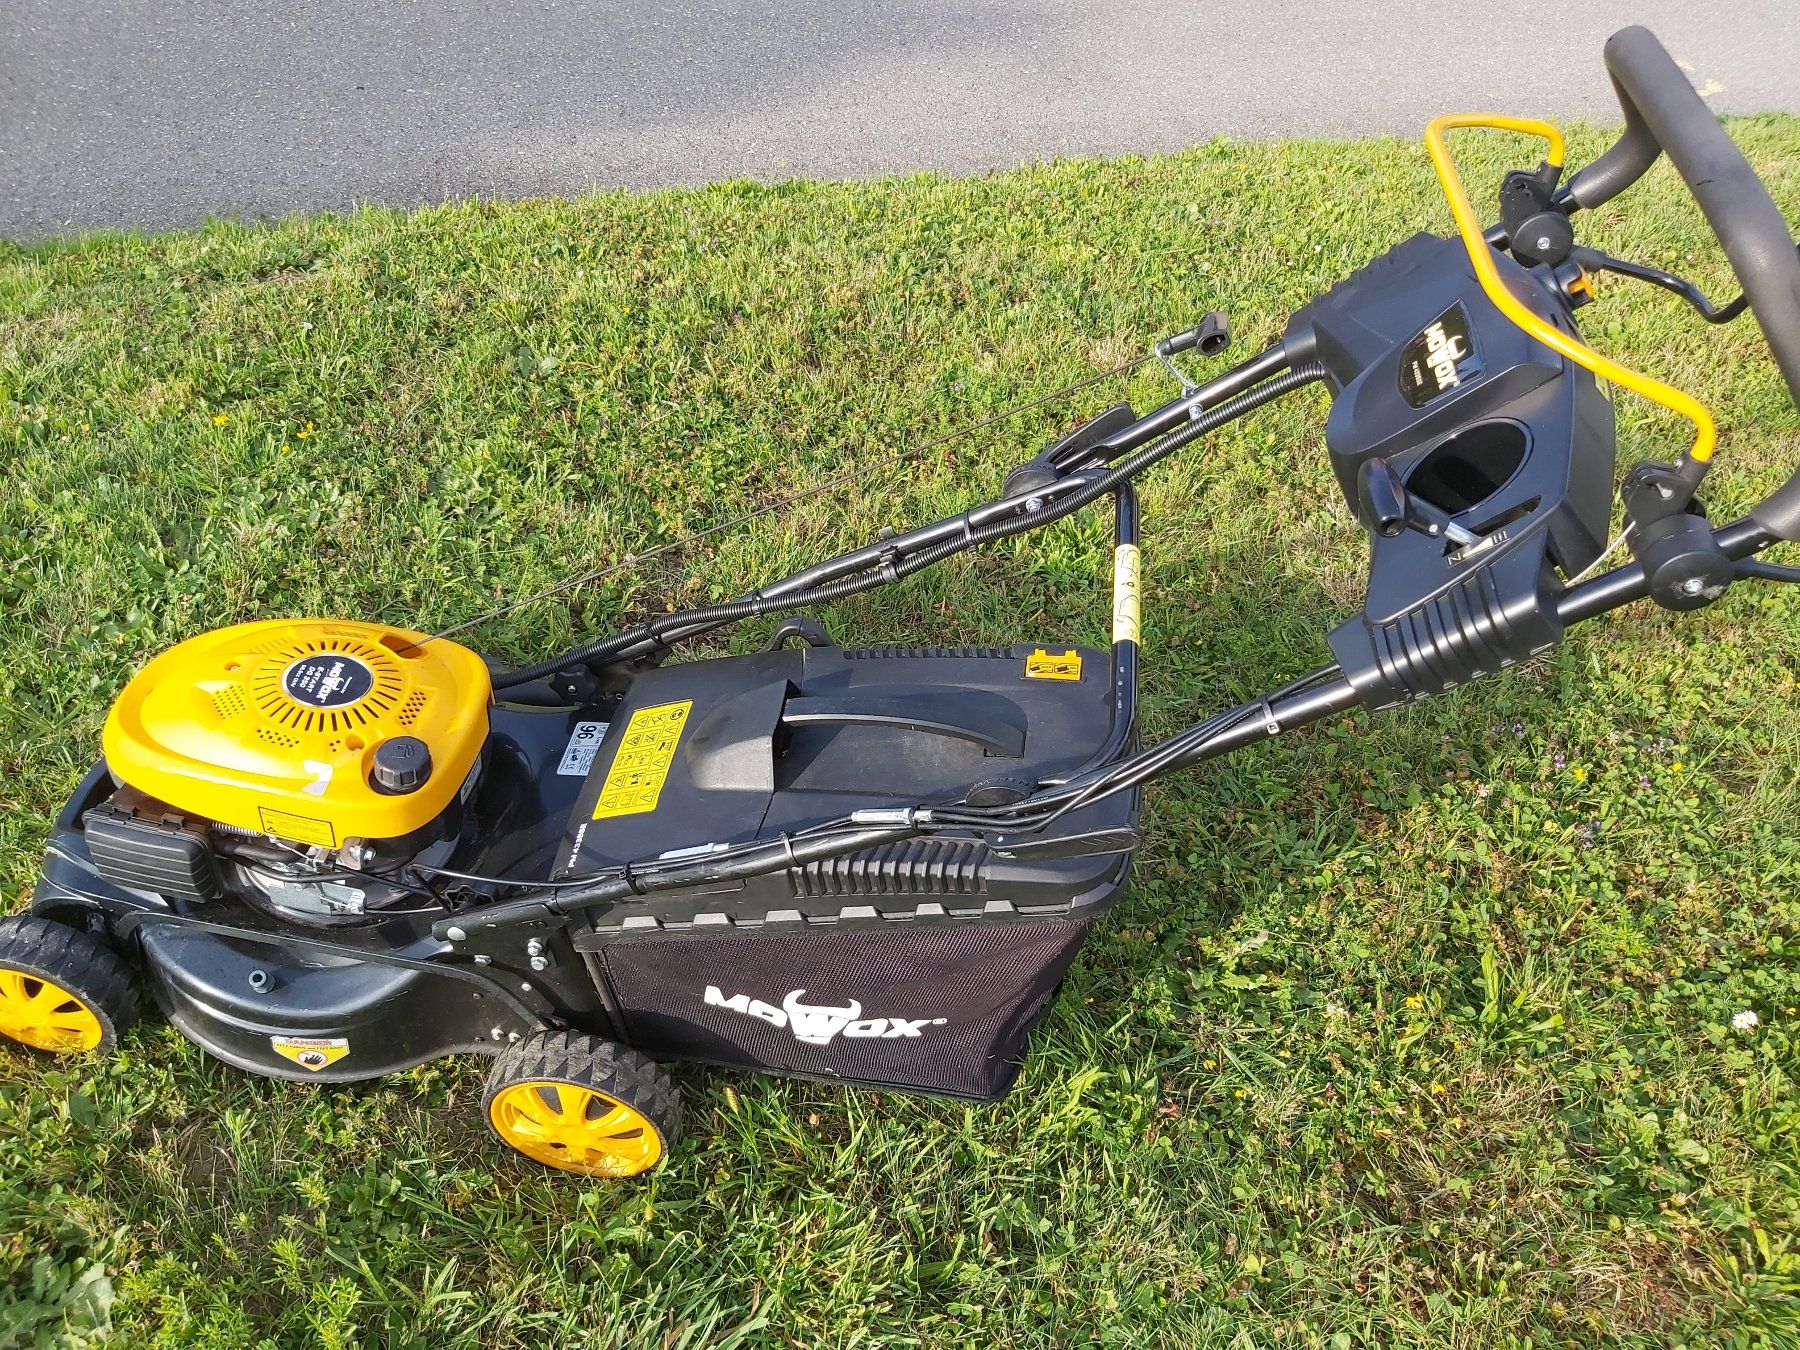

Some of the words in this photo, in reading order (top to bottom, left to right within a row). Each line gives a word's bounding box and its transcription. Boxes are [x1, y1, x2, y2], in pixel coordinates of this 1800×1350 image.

[1424, 321, 1466, 391] MOWOX
[305, 666, 325, 693] E-START
[316, 661, 346, 703] MOWOX
[577, 725, 598, 740] 96
[568, 854, 578, 868] PM
